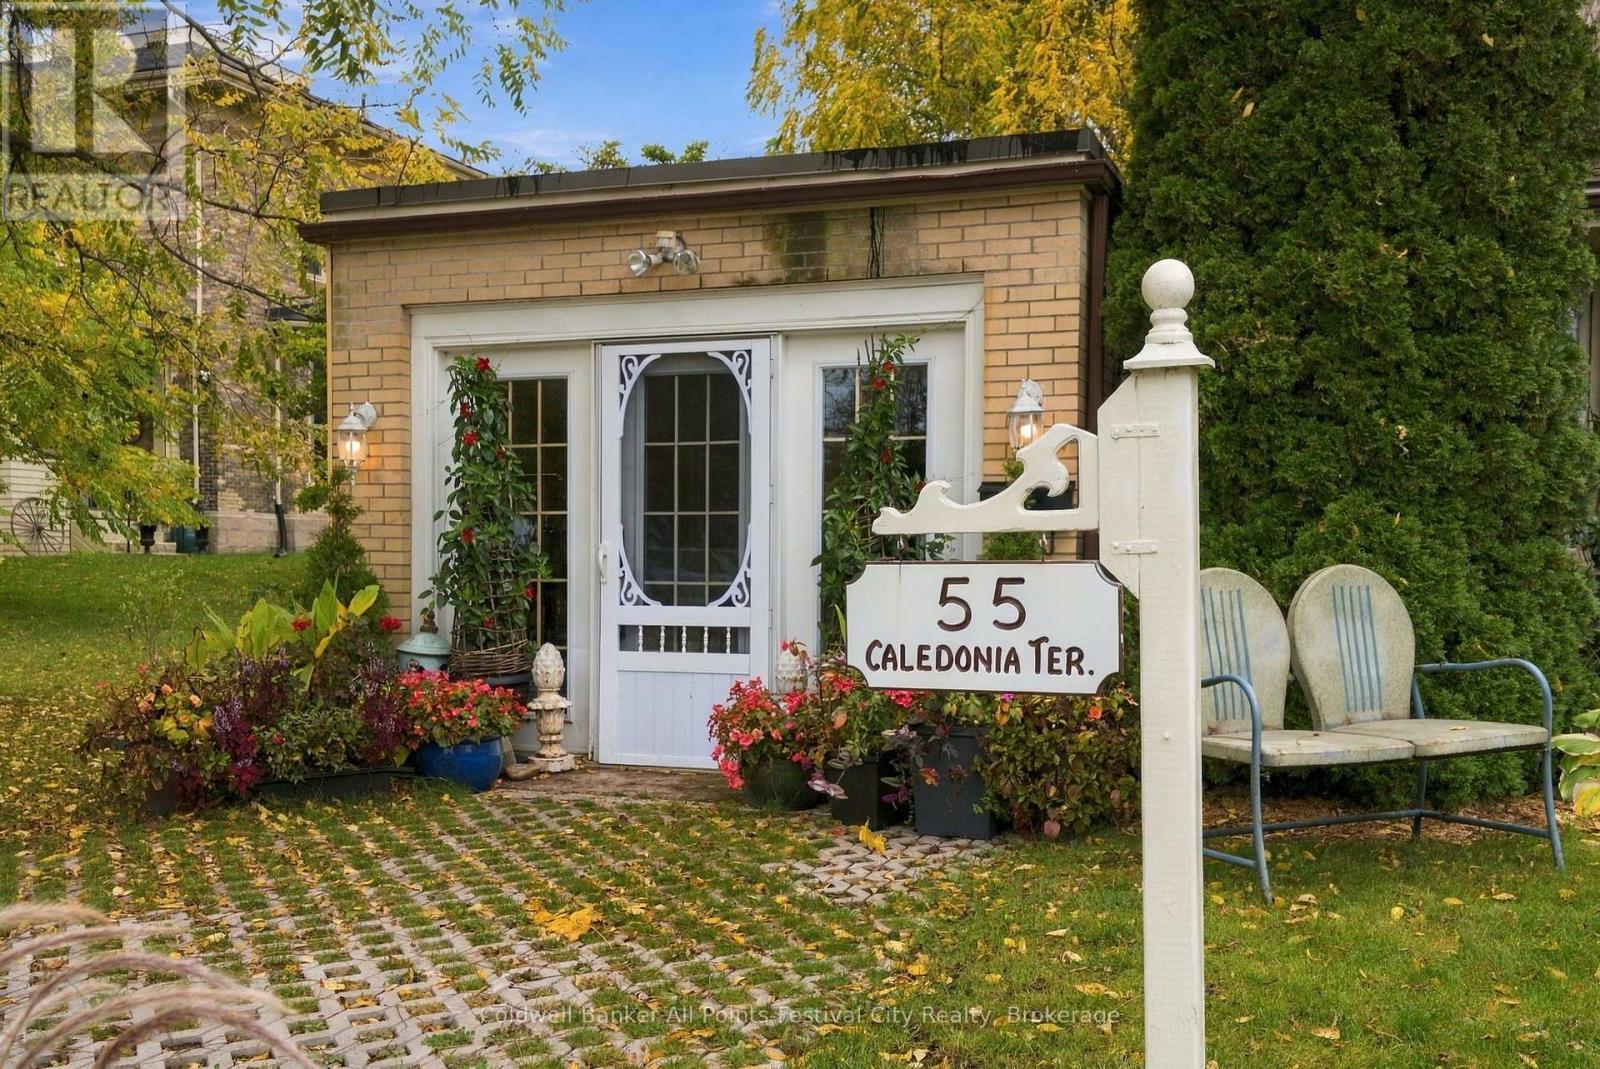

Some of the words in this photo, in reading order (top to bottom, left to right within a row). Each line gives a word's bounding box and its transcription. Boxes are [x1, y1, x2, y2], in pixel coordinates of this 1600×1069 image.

[937, 576, 1027, 632] 55
[865, 639, 1021, 675] CALEDONIA
[1028, 636, 1095, 676] TER.
